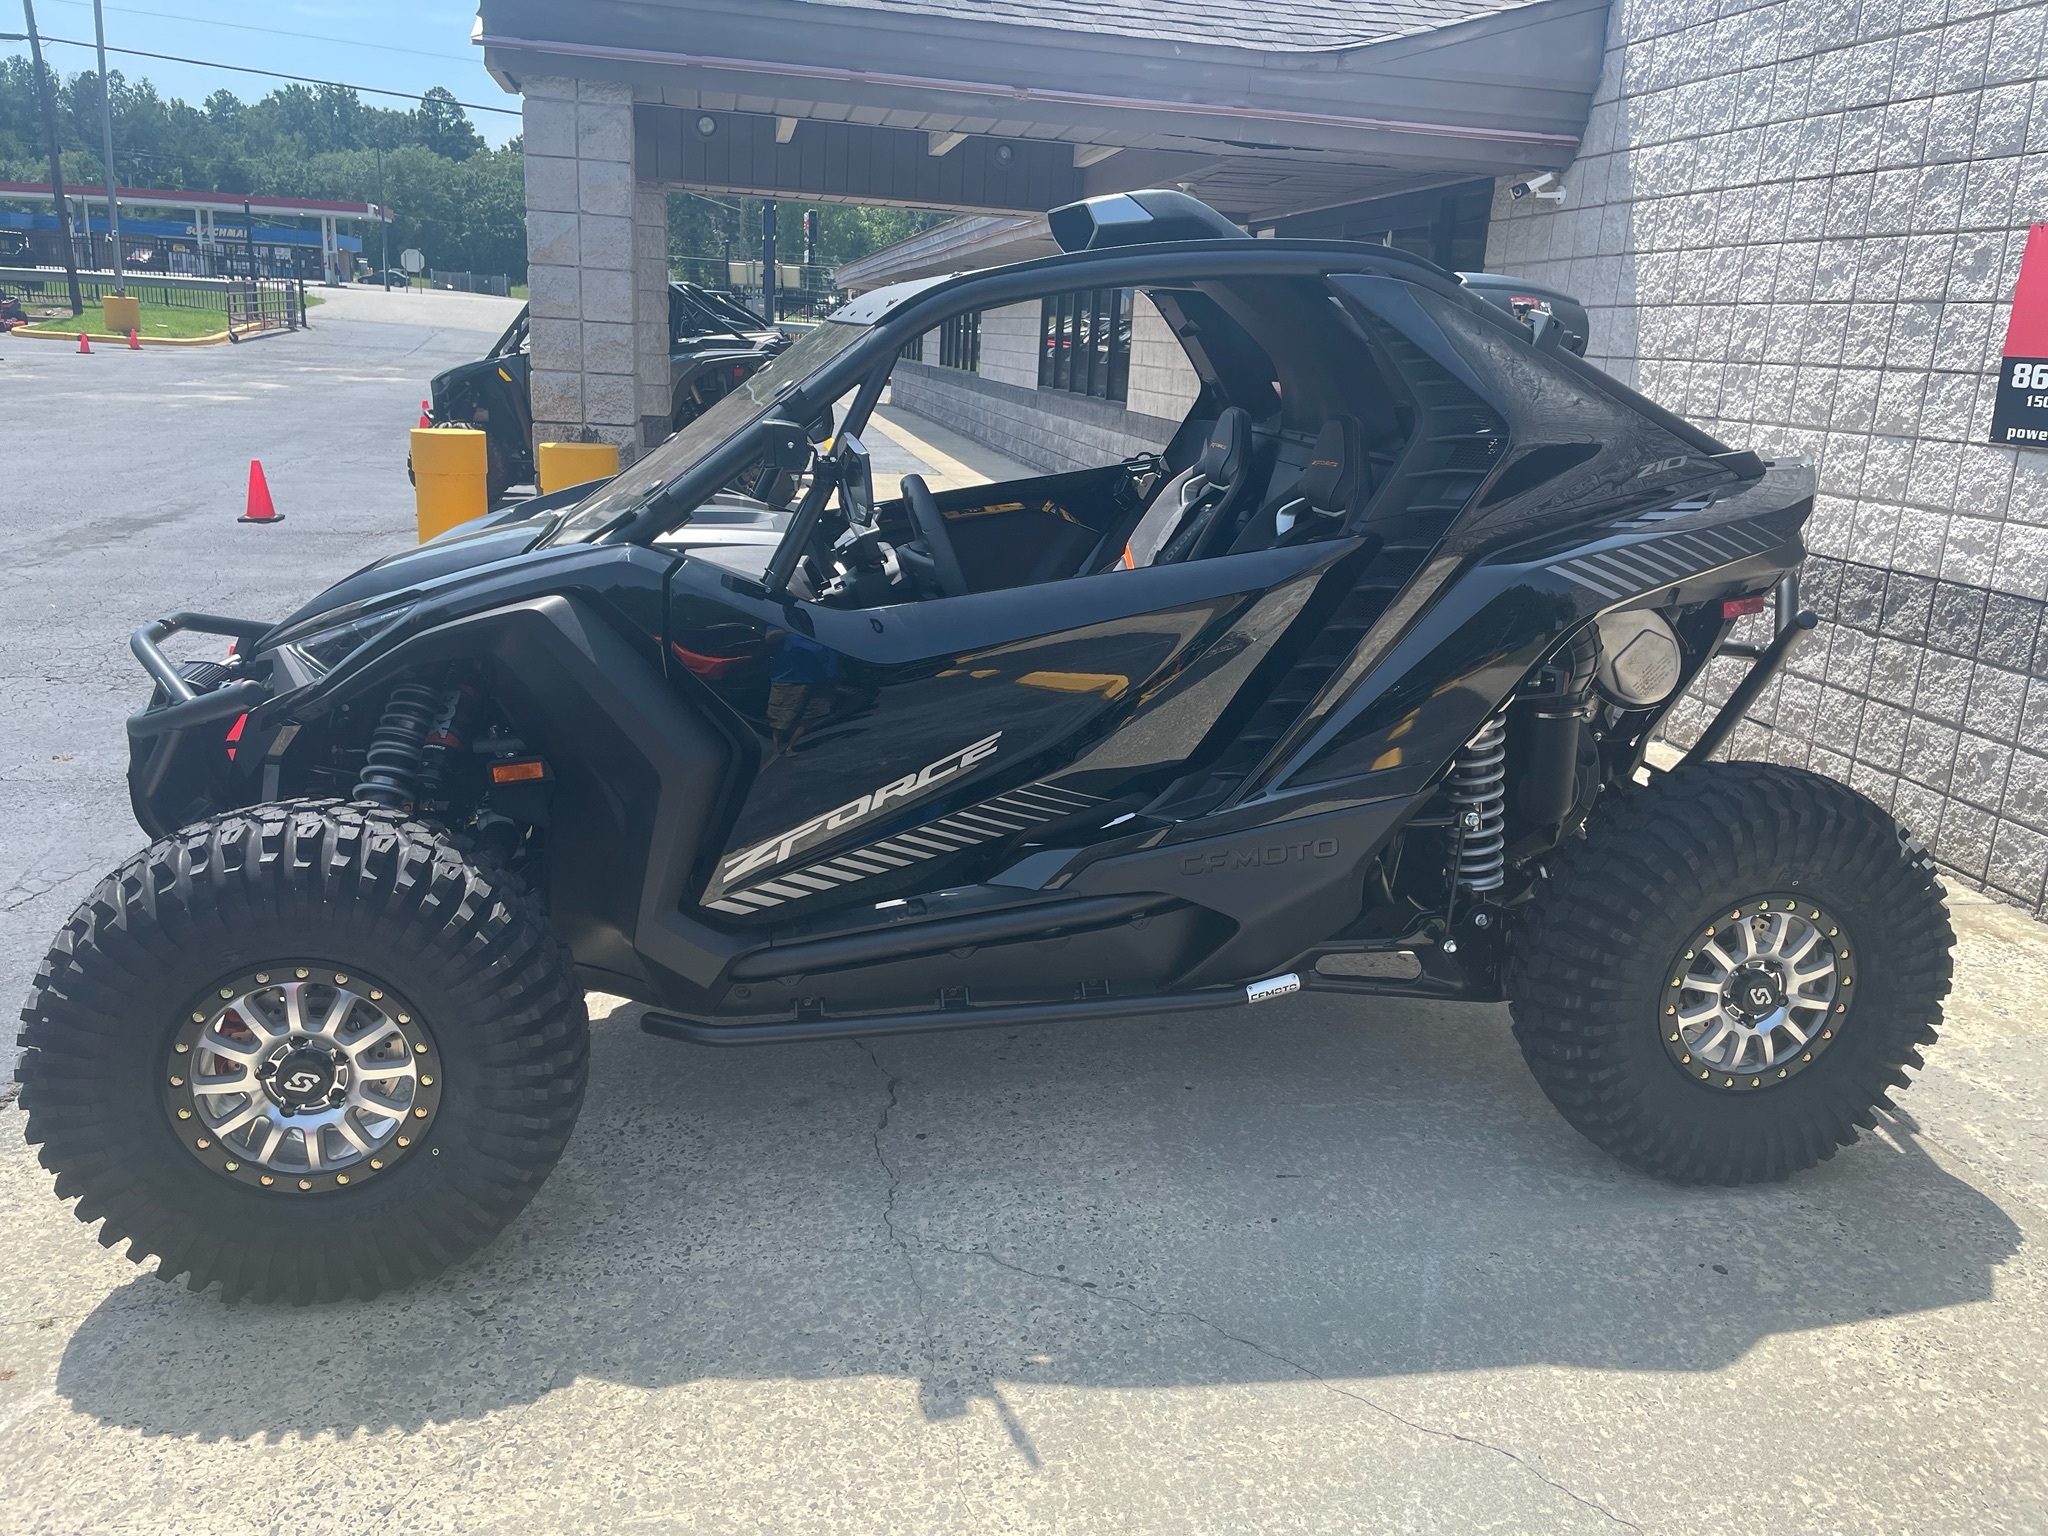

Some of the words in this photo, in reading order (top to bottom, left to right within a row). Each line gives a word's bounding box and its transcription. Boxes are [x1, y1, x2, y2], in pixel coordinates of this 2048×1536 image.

[2006, 427, 2048, 441] powe
[722, 730, 1003, 884] ZFORCE
[1180, 837, 1339, 876] CFMOTO
[1250, 983, 1298, 1001] CFMOTO
